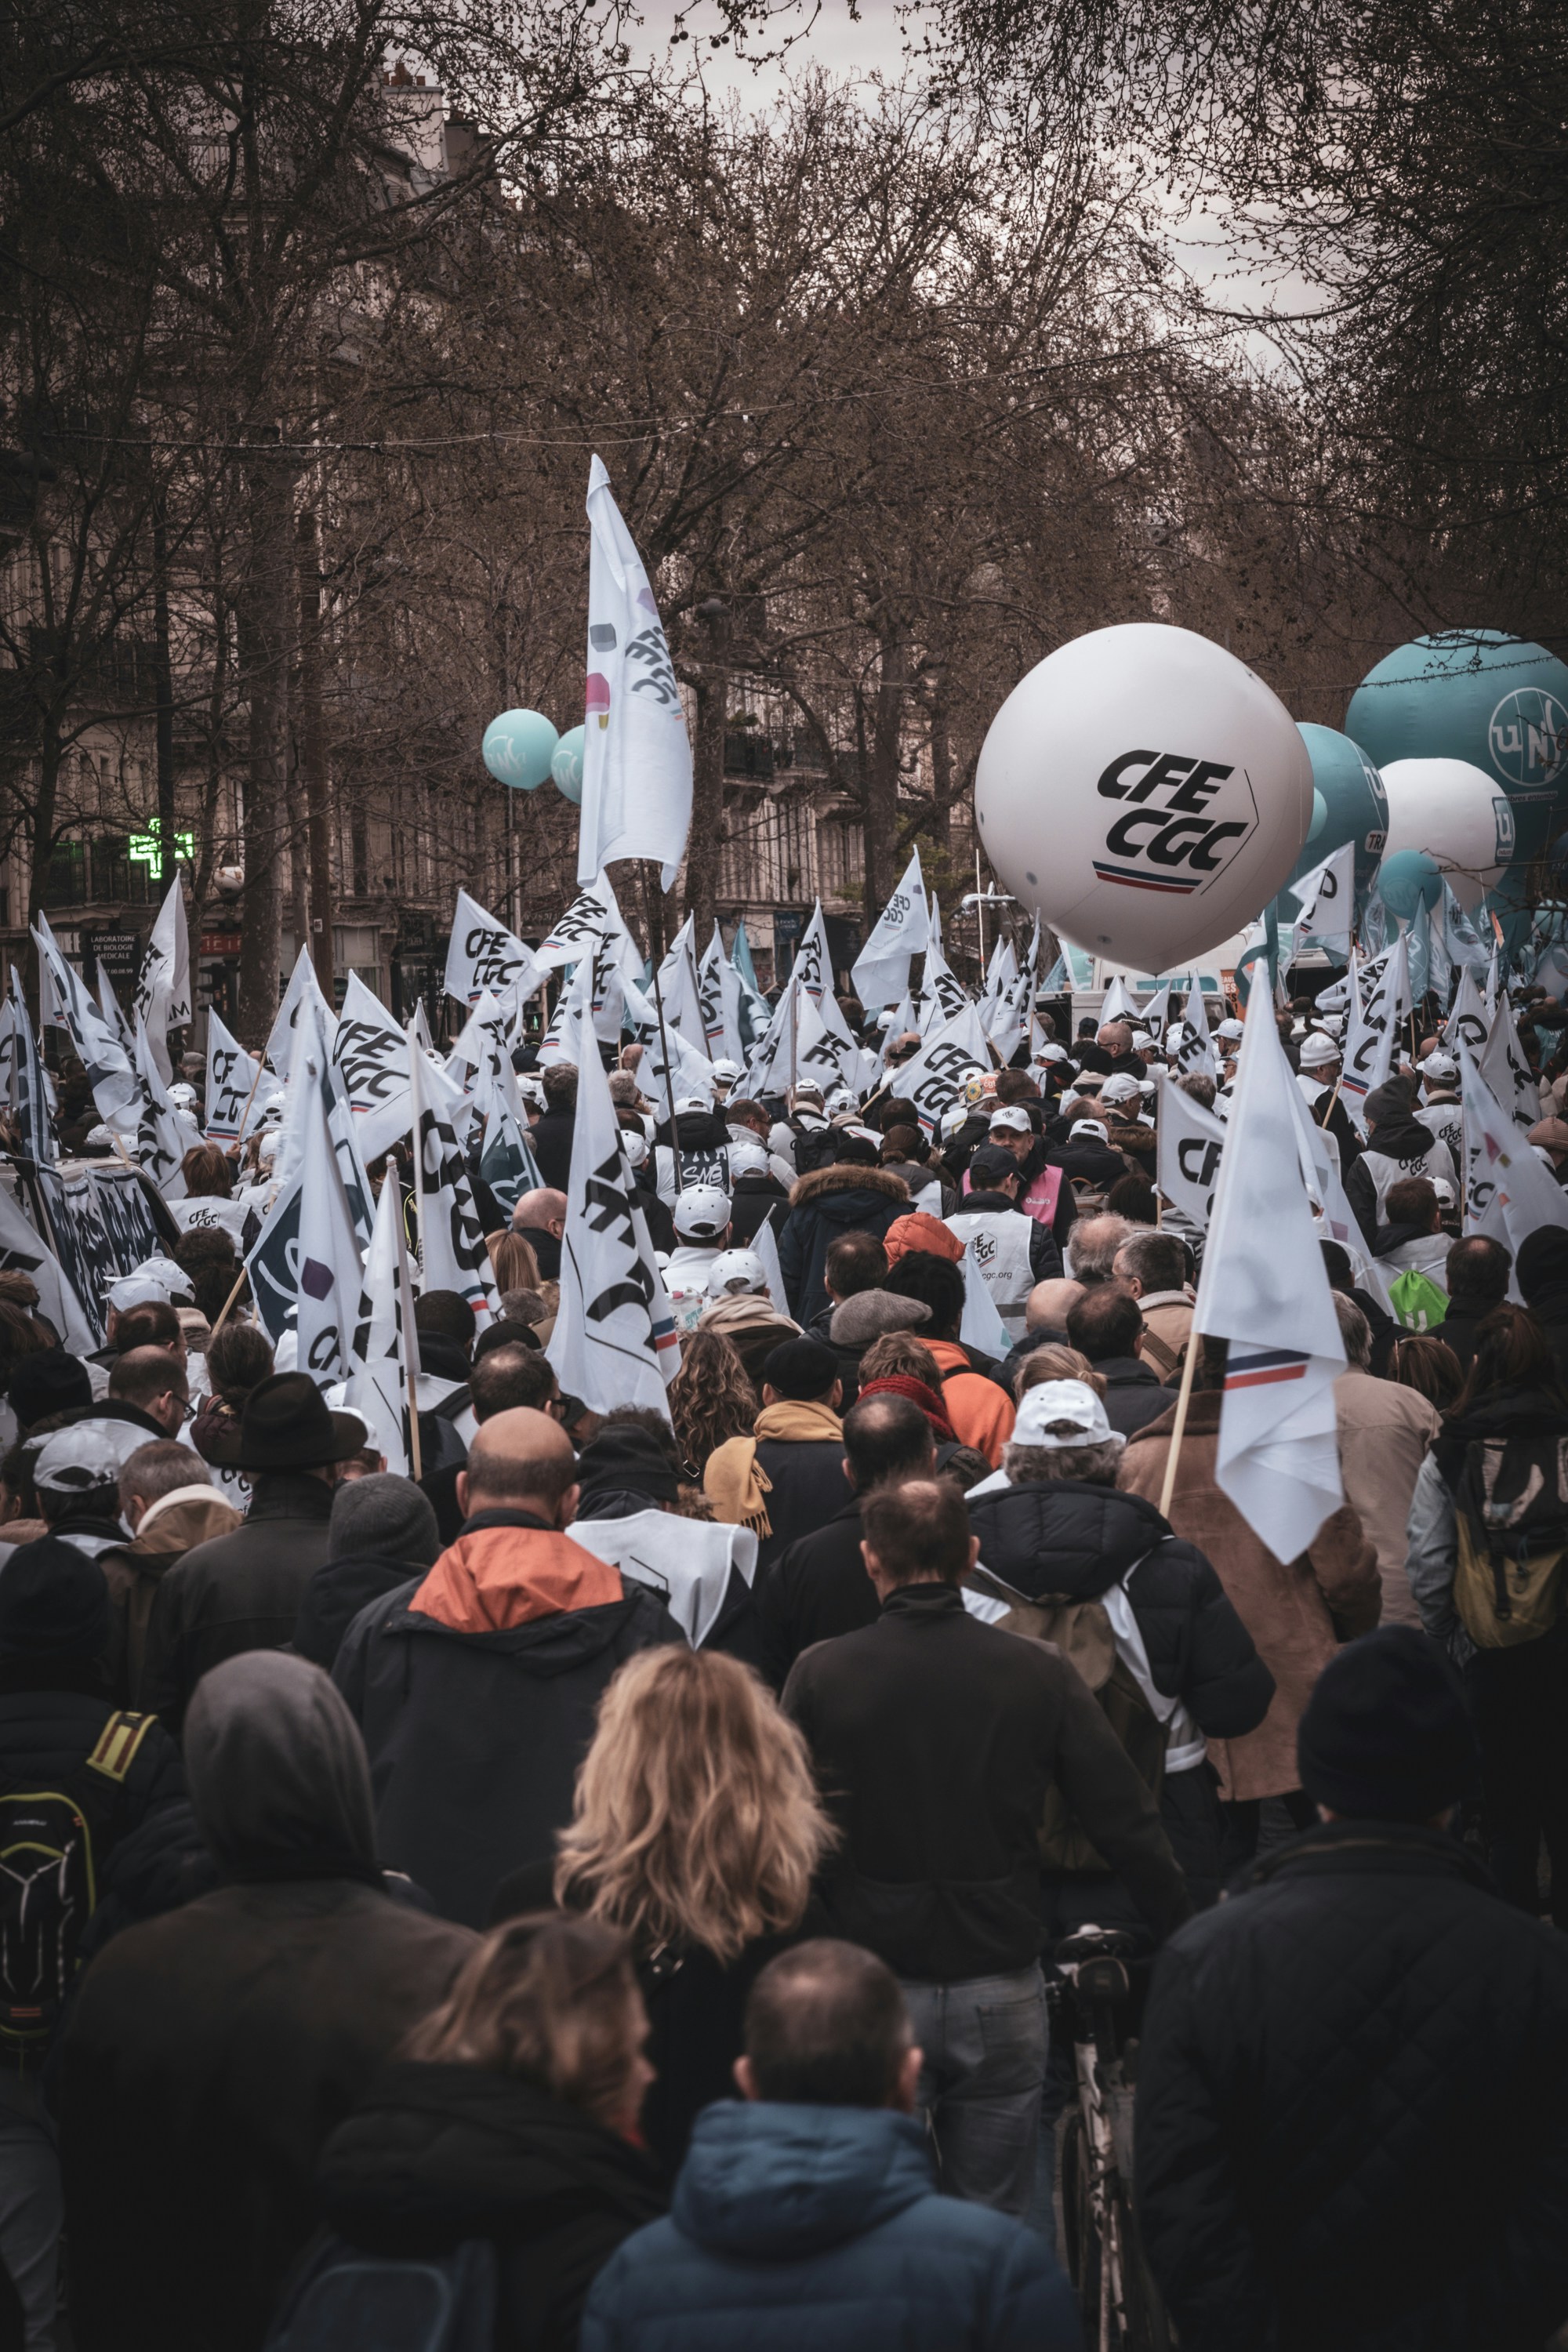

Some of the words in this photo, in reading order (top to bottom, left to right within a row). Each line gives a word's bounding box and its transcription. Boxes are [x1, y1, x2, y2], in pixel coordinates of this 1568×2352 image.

[1098, 750, 1236, 814] CFE
[1106, 808, 1249, 872] CGC
[91, 934, 136, 942] LABORATOIRE
[466, 928, 510, 959] CFE
[332, 1019, 408, 1066] CFE
[1439, 1122, 1454, 1139] CFE
[1410, 1155, 1427, 1176] CGC
[189, 1208, 209, 1225] CFE
